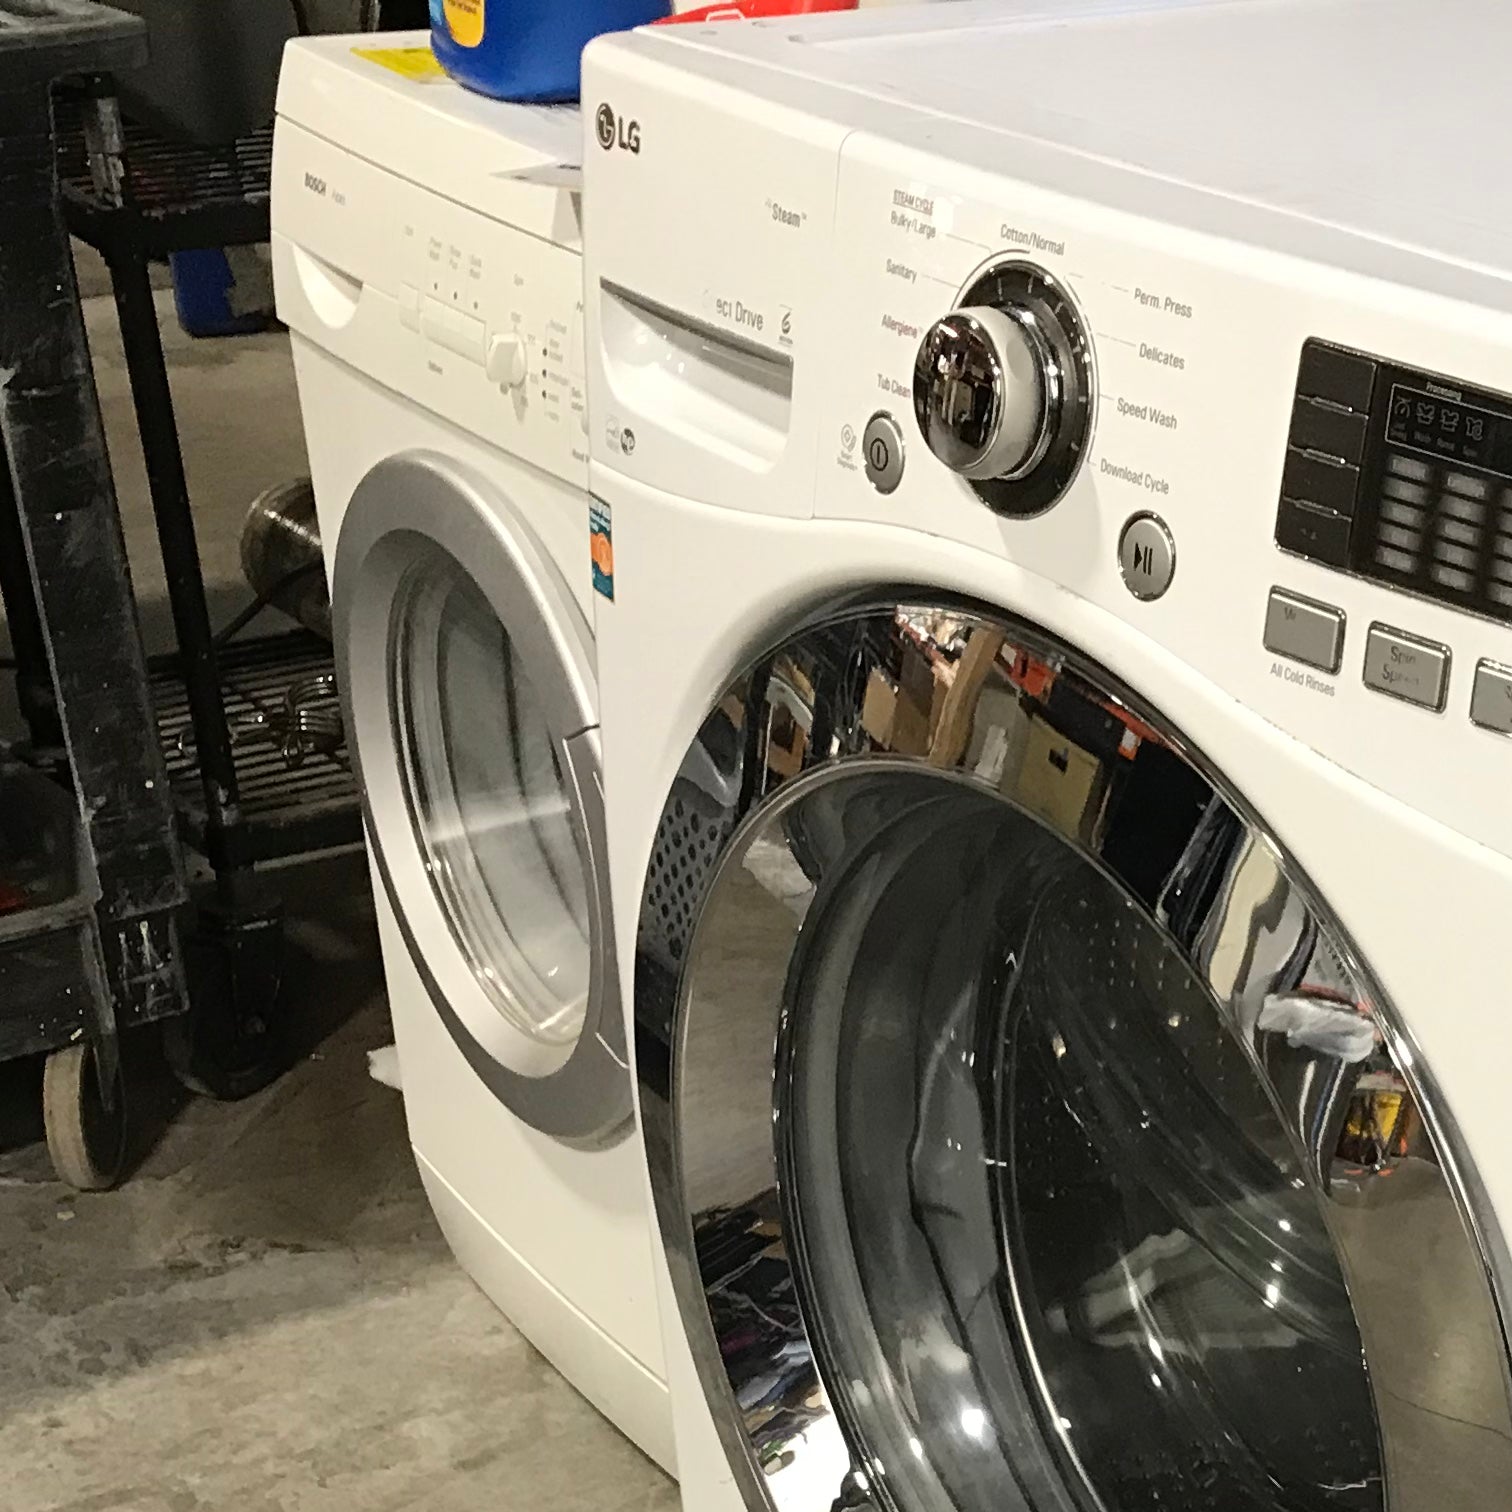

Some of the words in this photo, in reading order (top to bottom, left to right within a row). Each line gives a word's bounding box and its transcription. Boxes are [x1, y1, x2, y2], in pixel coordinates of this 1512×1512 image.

[618, 115, 641, 155] LG
[772, 203, 801, 228] Steam
[1000, 223, 1066, 256] Cotton/Normal
[886, 258, 918, 284] Sanitary
[735, 300, 764, 331] Drive
[1134, 287, 1162, 309] Perm.
[1164, 296, 1193, 318] Press
[1138, 342, 1185, 370] Delicates
[876, 373, 891, 391] Tub
[891, 380, 912, 399] Clean
[1117, 397, 1148, 420] Speed
[1149, 407, 1178, 430] Wash
[1100, 457, 1143, 486] Download
[1144, 473, 1170, 495] Cycle
[1270, 662, 1283, 677] All
[1283, 666, 1304, 686] Cold
[1305, 675, 1336, 697] Rinses
